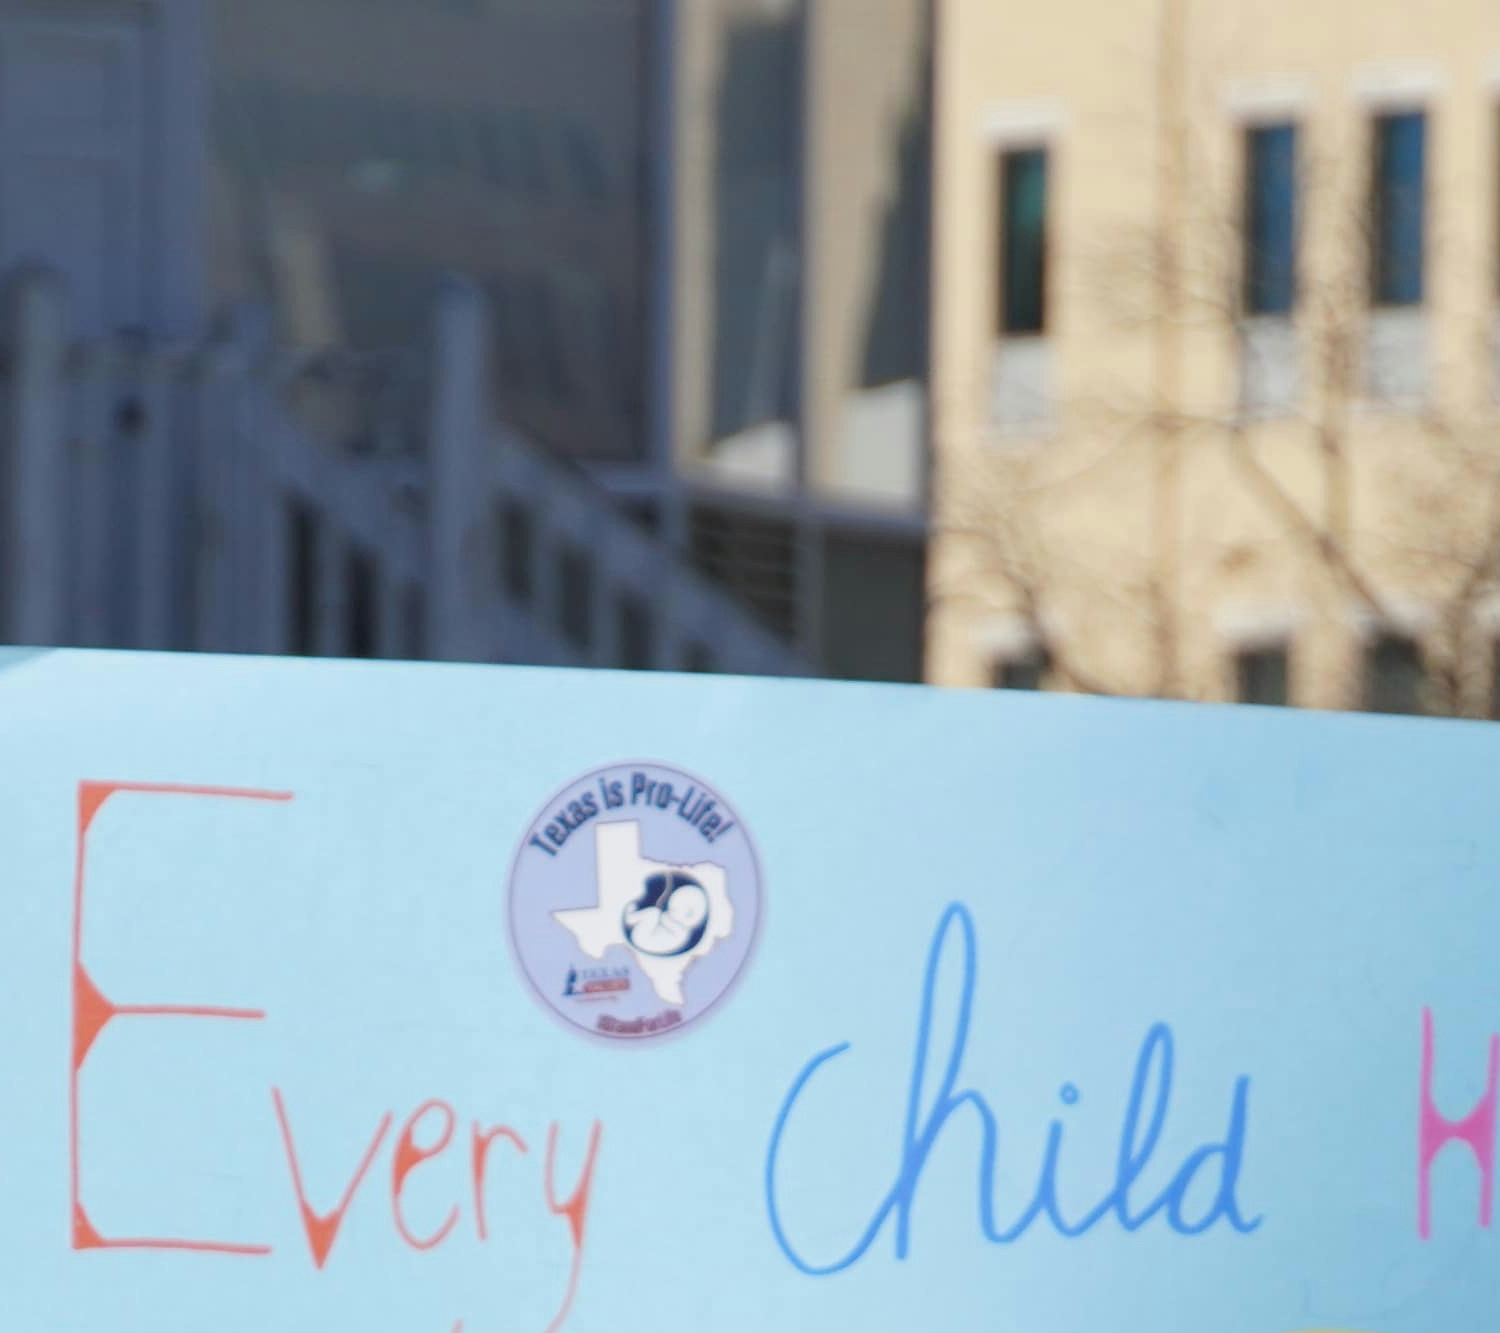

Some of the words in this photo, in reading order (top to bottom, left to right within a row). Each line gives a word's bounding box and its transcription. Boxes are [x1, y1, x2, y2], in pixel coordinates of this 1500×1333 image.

[527, 791, 599, 857] Texas
[598, 777, 625, 810] is
[630, 771, 736, 843] Pro-Life!
